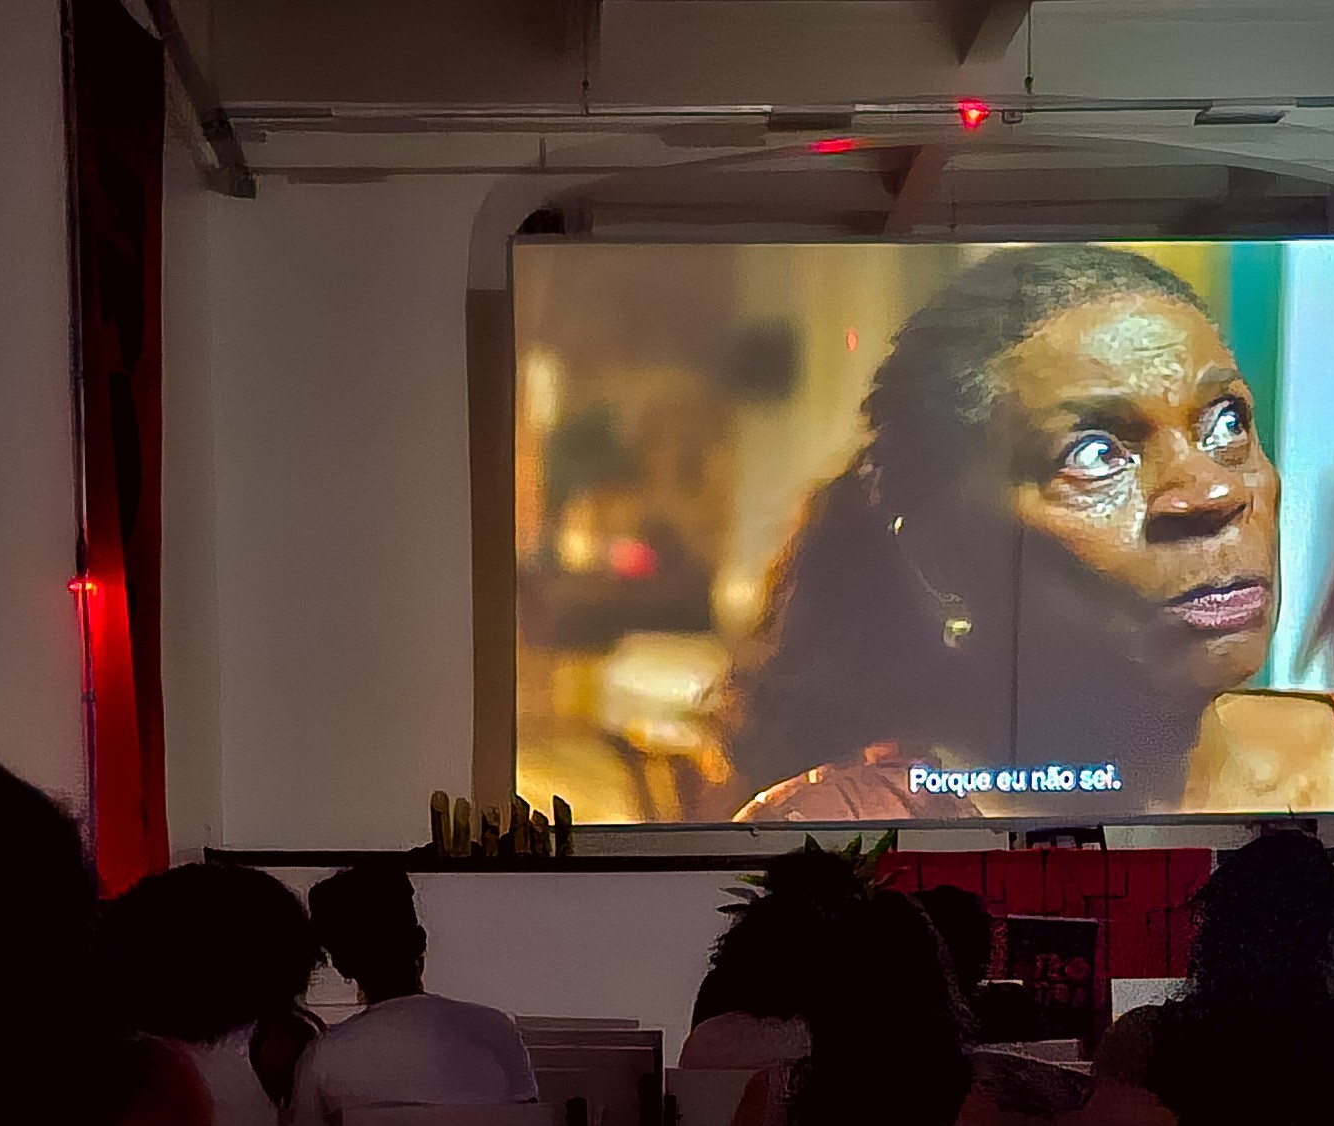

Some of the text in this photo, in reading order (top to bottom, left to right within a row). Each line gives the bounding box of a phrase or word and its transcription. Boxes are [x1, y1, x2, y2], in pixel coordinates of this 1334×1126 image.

[909, 763, 1122, 798] Porque eu não sei.
